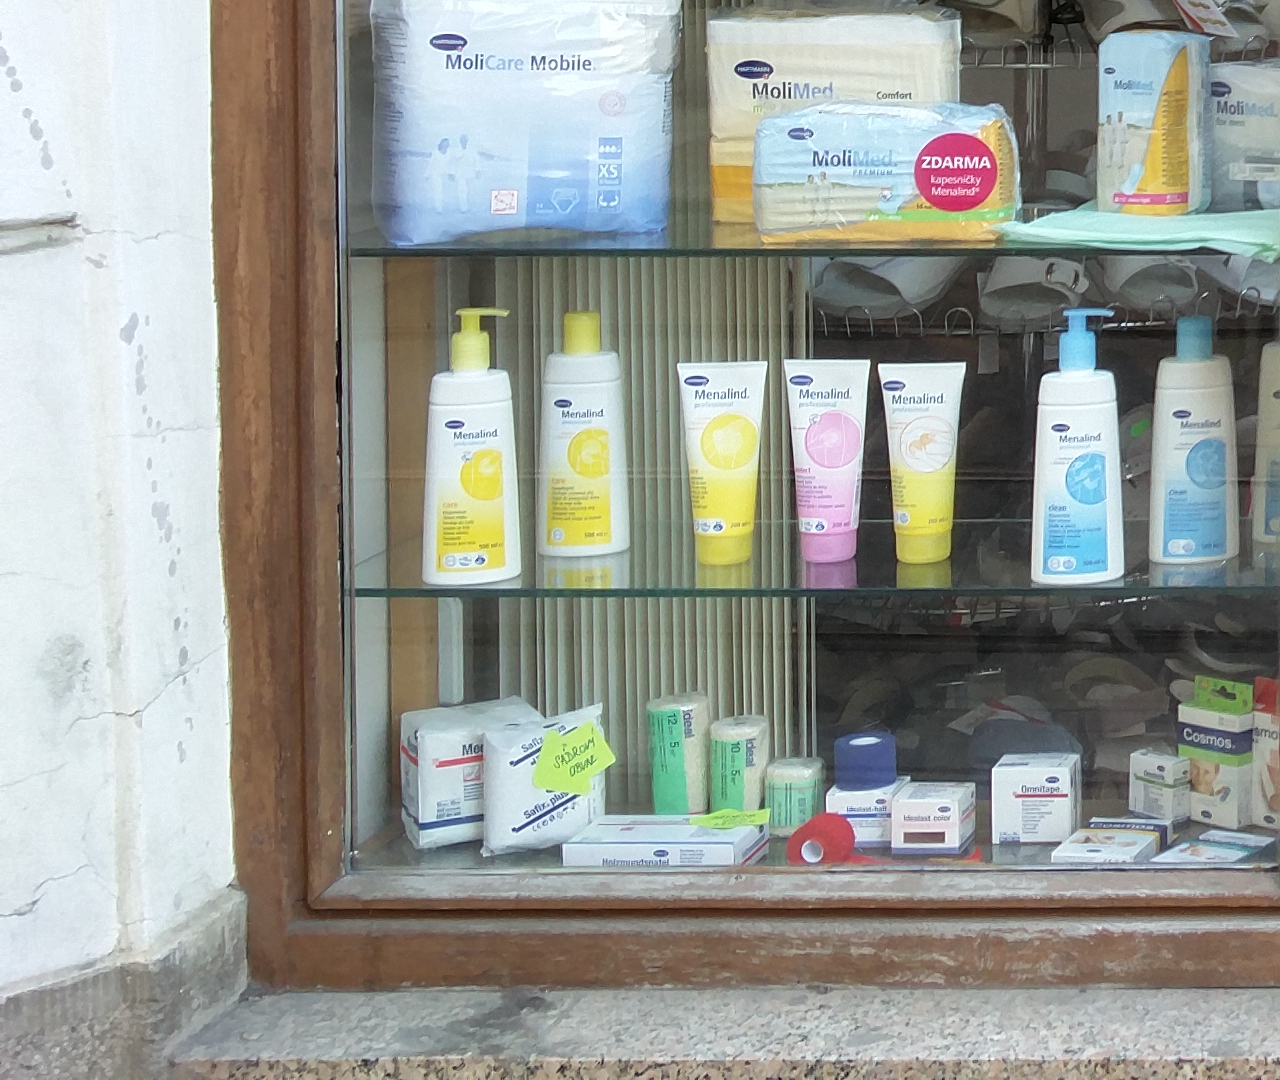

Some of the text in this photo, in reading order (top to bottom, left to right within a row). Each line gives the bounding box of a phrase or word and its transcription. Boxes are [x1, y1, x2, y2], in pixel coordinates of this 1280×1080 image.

[445, 53, 593, 72] MoliCare Mobile
[752, 82, 913, 101] MoliMed Comfort
[921, 155, 992, 170] ZDARMA
[599, 164, 618, 178] XS
[930, 173, 982, 186] kapesníčky
[694, 387, 748, 401] Menalind
[798, 387, 850, 401] Menalind
[891, 393, 944, 406] Menalind
[561, 408, 604, 420] Menalind
[453, 429, 498, 440] Menalind
[1058, 432, 1102, 443] Menalind
[666, 712, 678, 726] 12
[1183, 727, 1232, 749] Cosmos
[1254, 727, 1278, 741] smo
[730, 740, 741, 754] 10
[745, 737, 757, 768] Ideal
[1021, 784, 1061, 794] Omnitape
